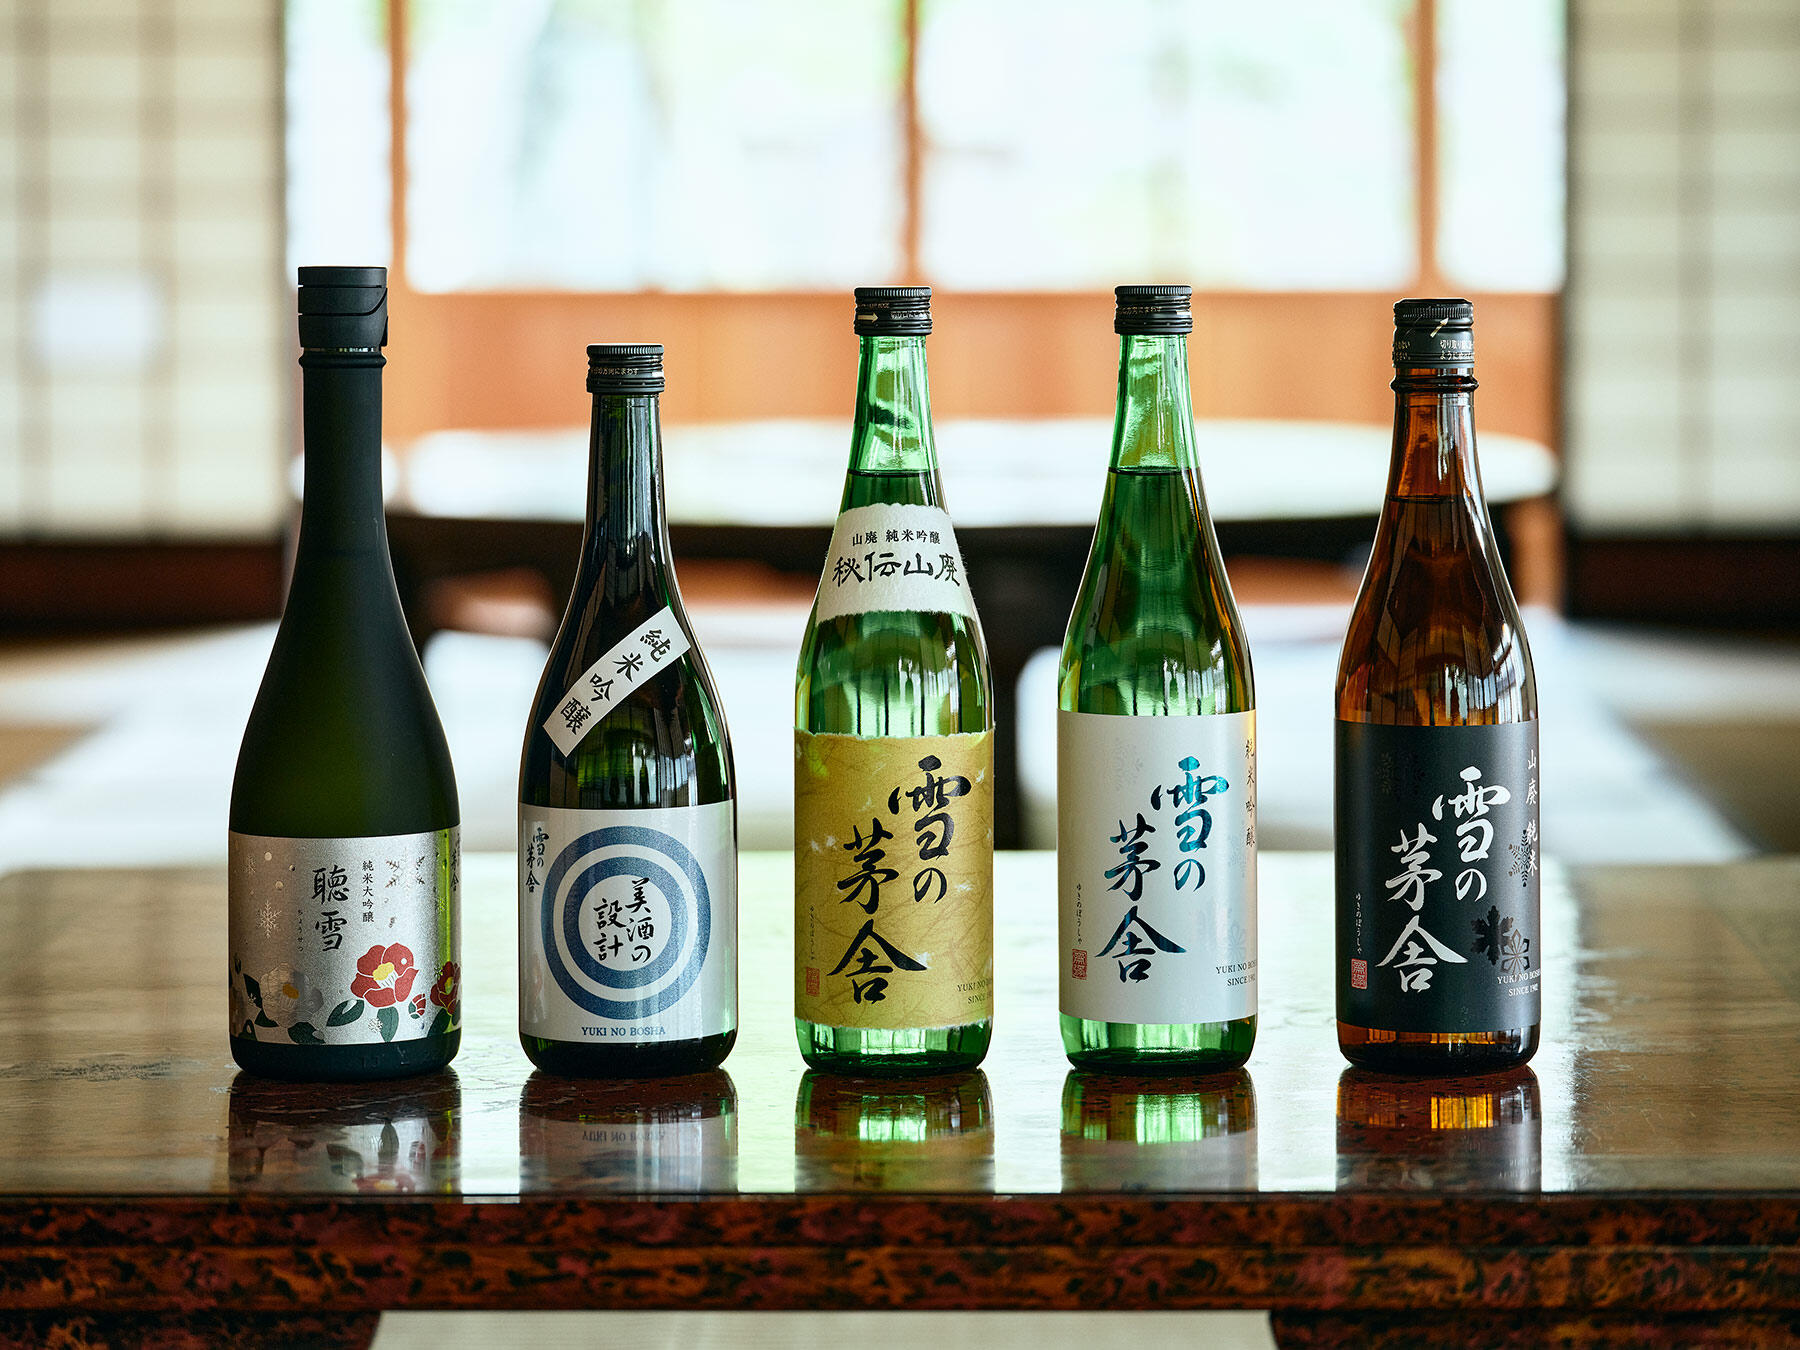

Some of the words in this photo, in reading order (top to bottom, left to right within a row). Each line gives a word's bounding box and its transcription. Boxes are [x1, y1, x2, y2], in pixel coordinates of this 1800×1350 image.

[885, 529, 941, 545] 純米吟醸
[560, 629, 671, 735] 純米吟醸
[362, 860, 374, 923] 純米大吟醸
[625, 877, 654, 963] 美酒の
[593, 898, 627, 961] 設計
[1215, 964, 1236, 974] YUKI
[1237, 962, 1247, 971] NO
[1227, 976, 1247, 987] SINCE
[1497, 974, 1518, 984] YUKI
[1519, 972, 1529, 981] NO
[1508, 985, 1529, 996] SINCE
[581, 1026, 607, 1037] YUKI
[611, 1026, 627, 1037] NO
[630, 1026, 666, 1036] BOSHA
